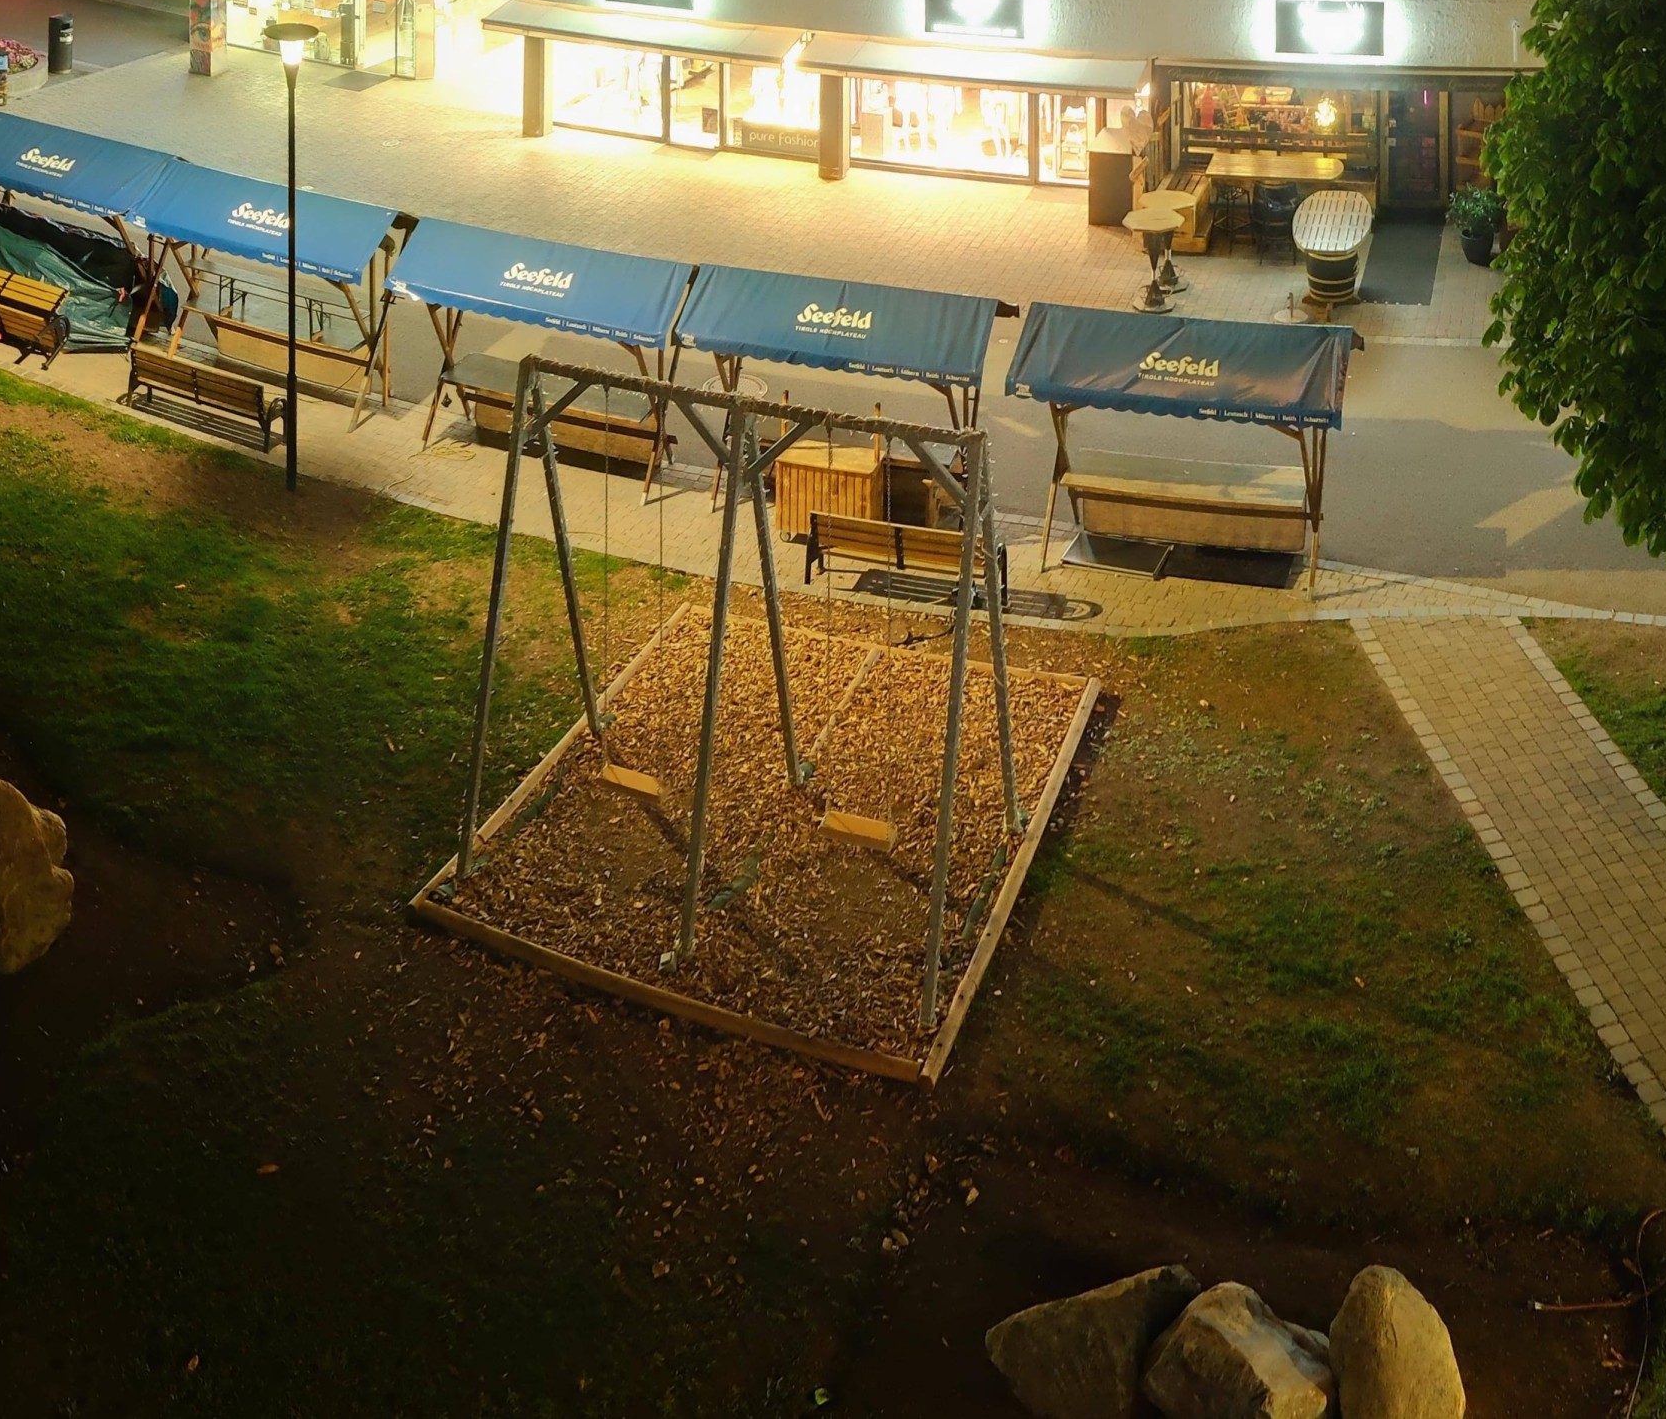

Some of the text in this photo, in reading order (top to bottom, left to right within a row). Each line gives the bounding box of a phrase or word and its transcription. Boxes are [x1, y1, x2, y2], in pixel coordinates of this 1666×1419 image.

[749, 131, 775, 143] pure
[20, 147, 76, 172] Seefeld
[231, 202, 290, 229] Seefeld
[503, 262, 574, 290] Seefeld
[796, 302, 873, 330] Seefeld
[1139, 351, 1219, 377] Seefeld
